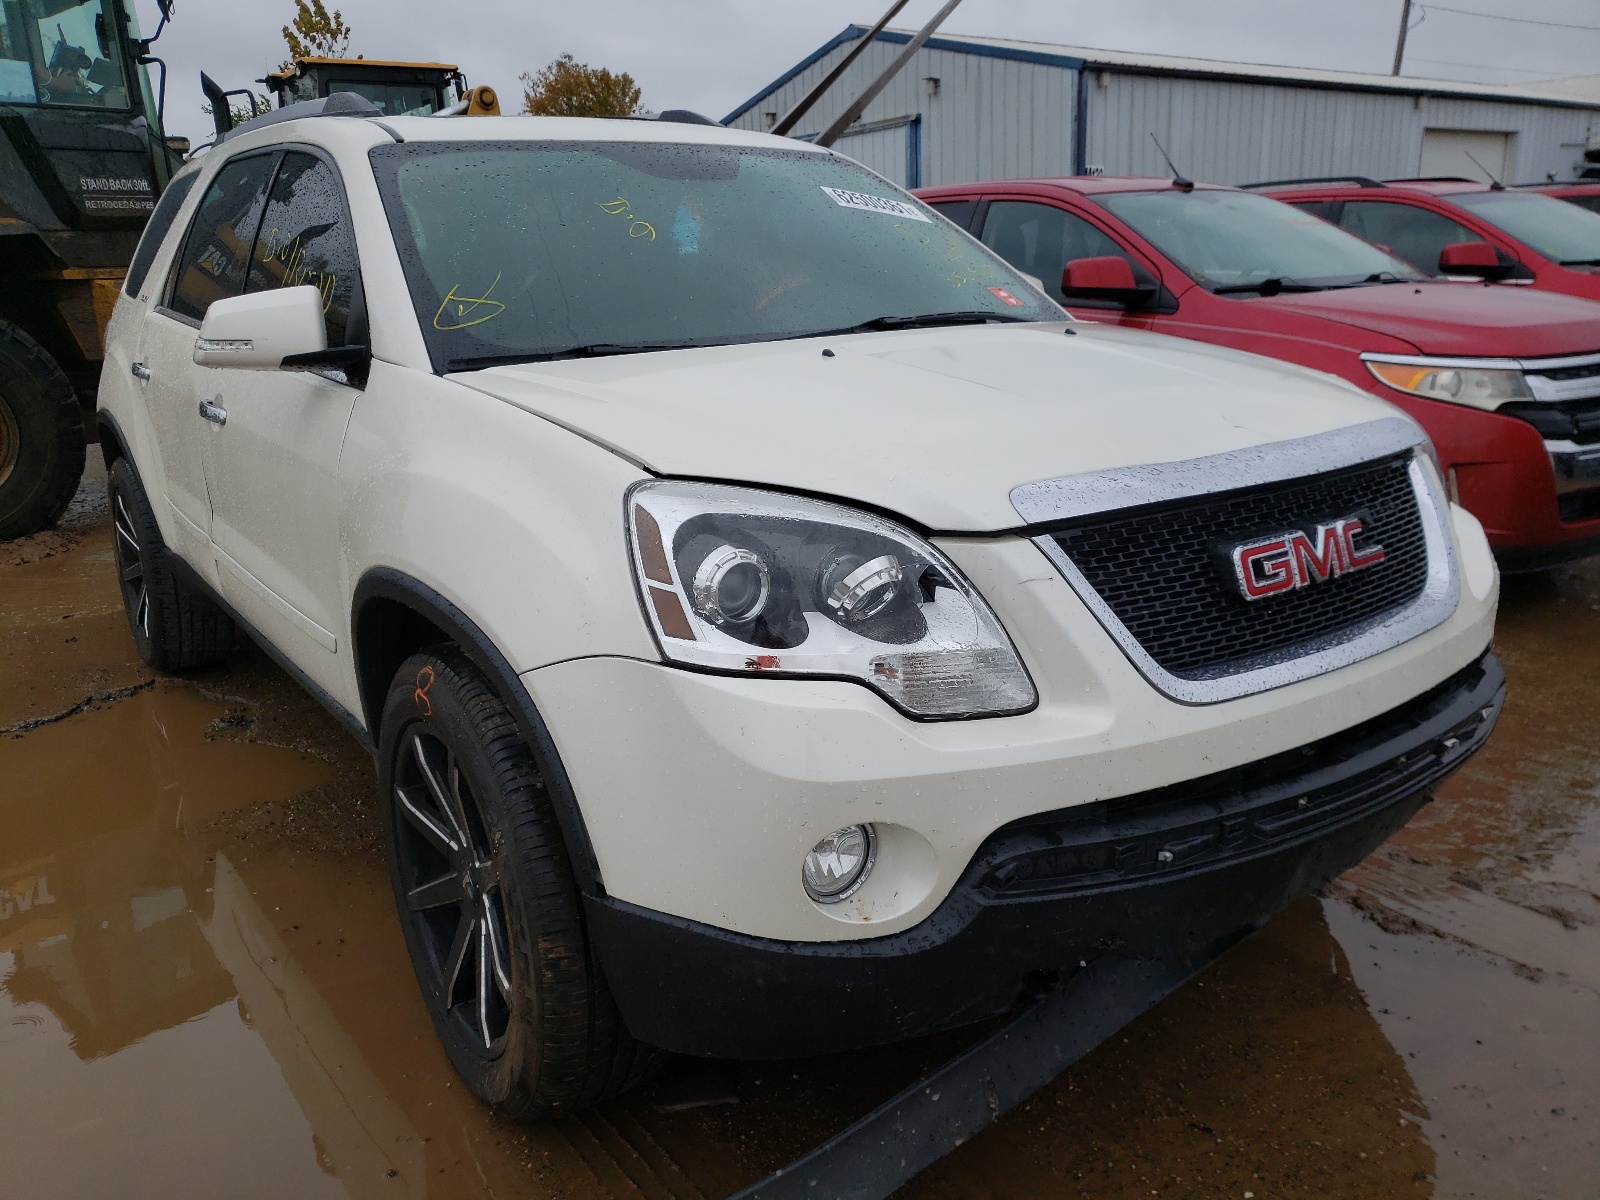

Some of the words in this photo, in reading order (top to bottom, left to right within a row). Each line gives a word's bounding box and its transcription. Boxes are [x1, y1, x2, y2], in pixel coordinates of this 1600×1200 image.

[80, 178, 109, 190] STAND
[109, 179, 133, 190] BACK
[85, 200, 134, 209] RETROCEDA
[832, 188, 912, 216] 62500361
[1231, 519, 1385, 602] GMC
